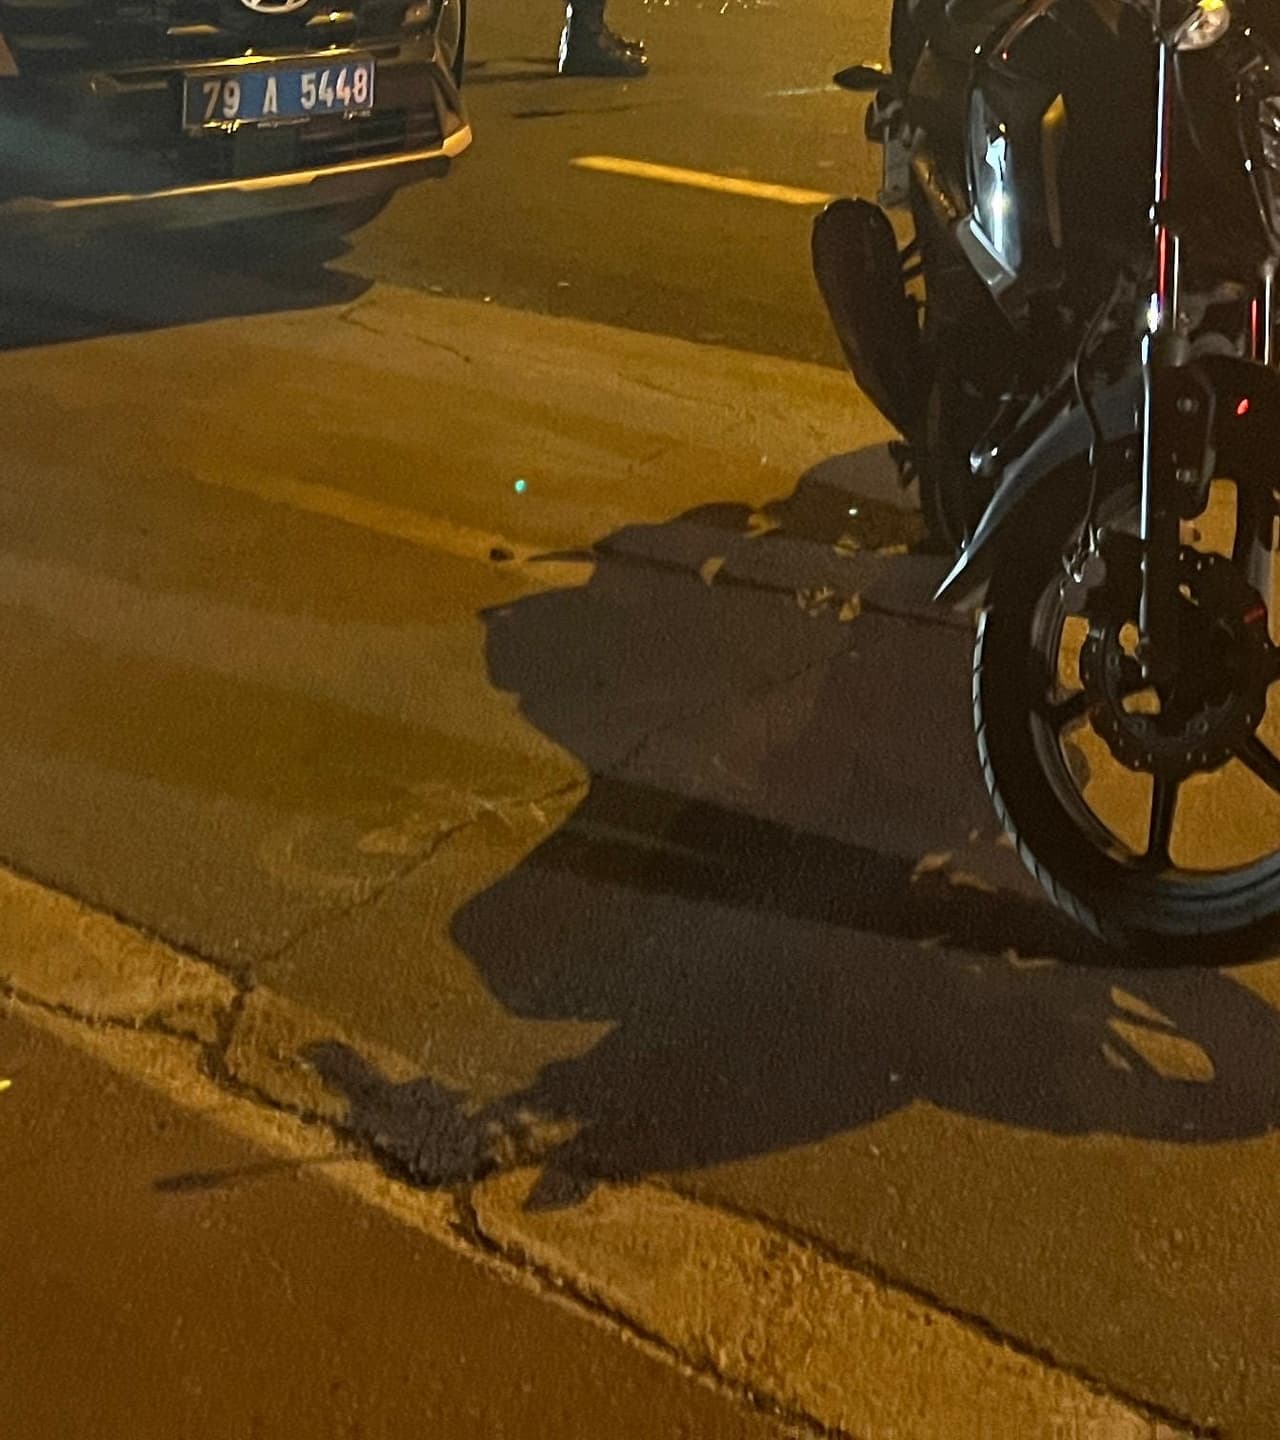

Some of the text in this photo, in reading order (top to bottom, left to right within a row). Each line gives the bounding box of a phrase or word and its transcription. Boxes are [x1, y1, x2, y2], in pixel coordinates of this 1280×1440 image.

[202, 67, 368, 119] 79 A 5448
